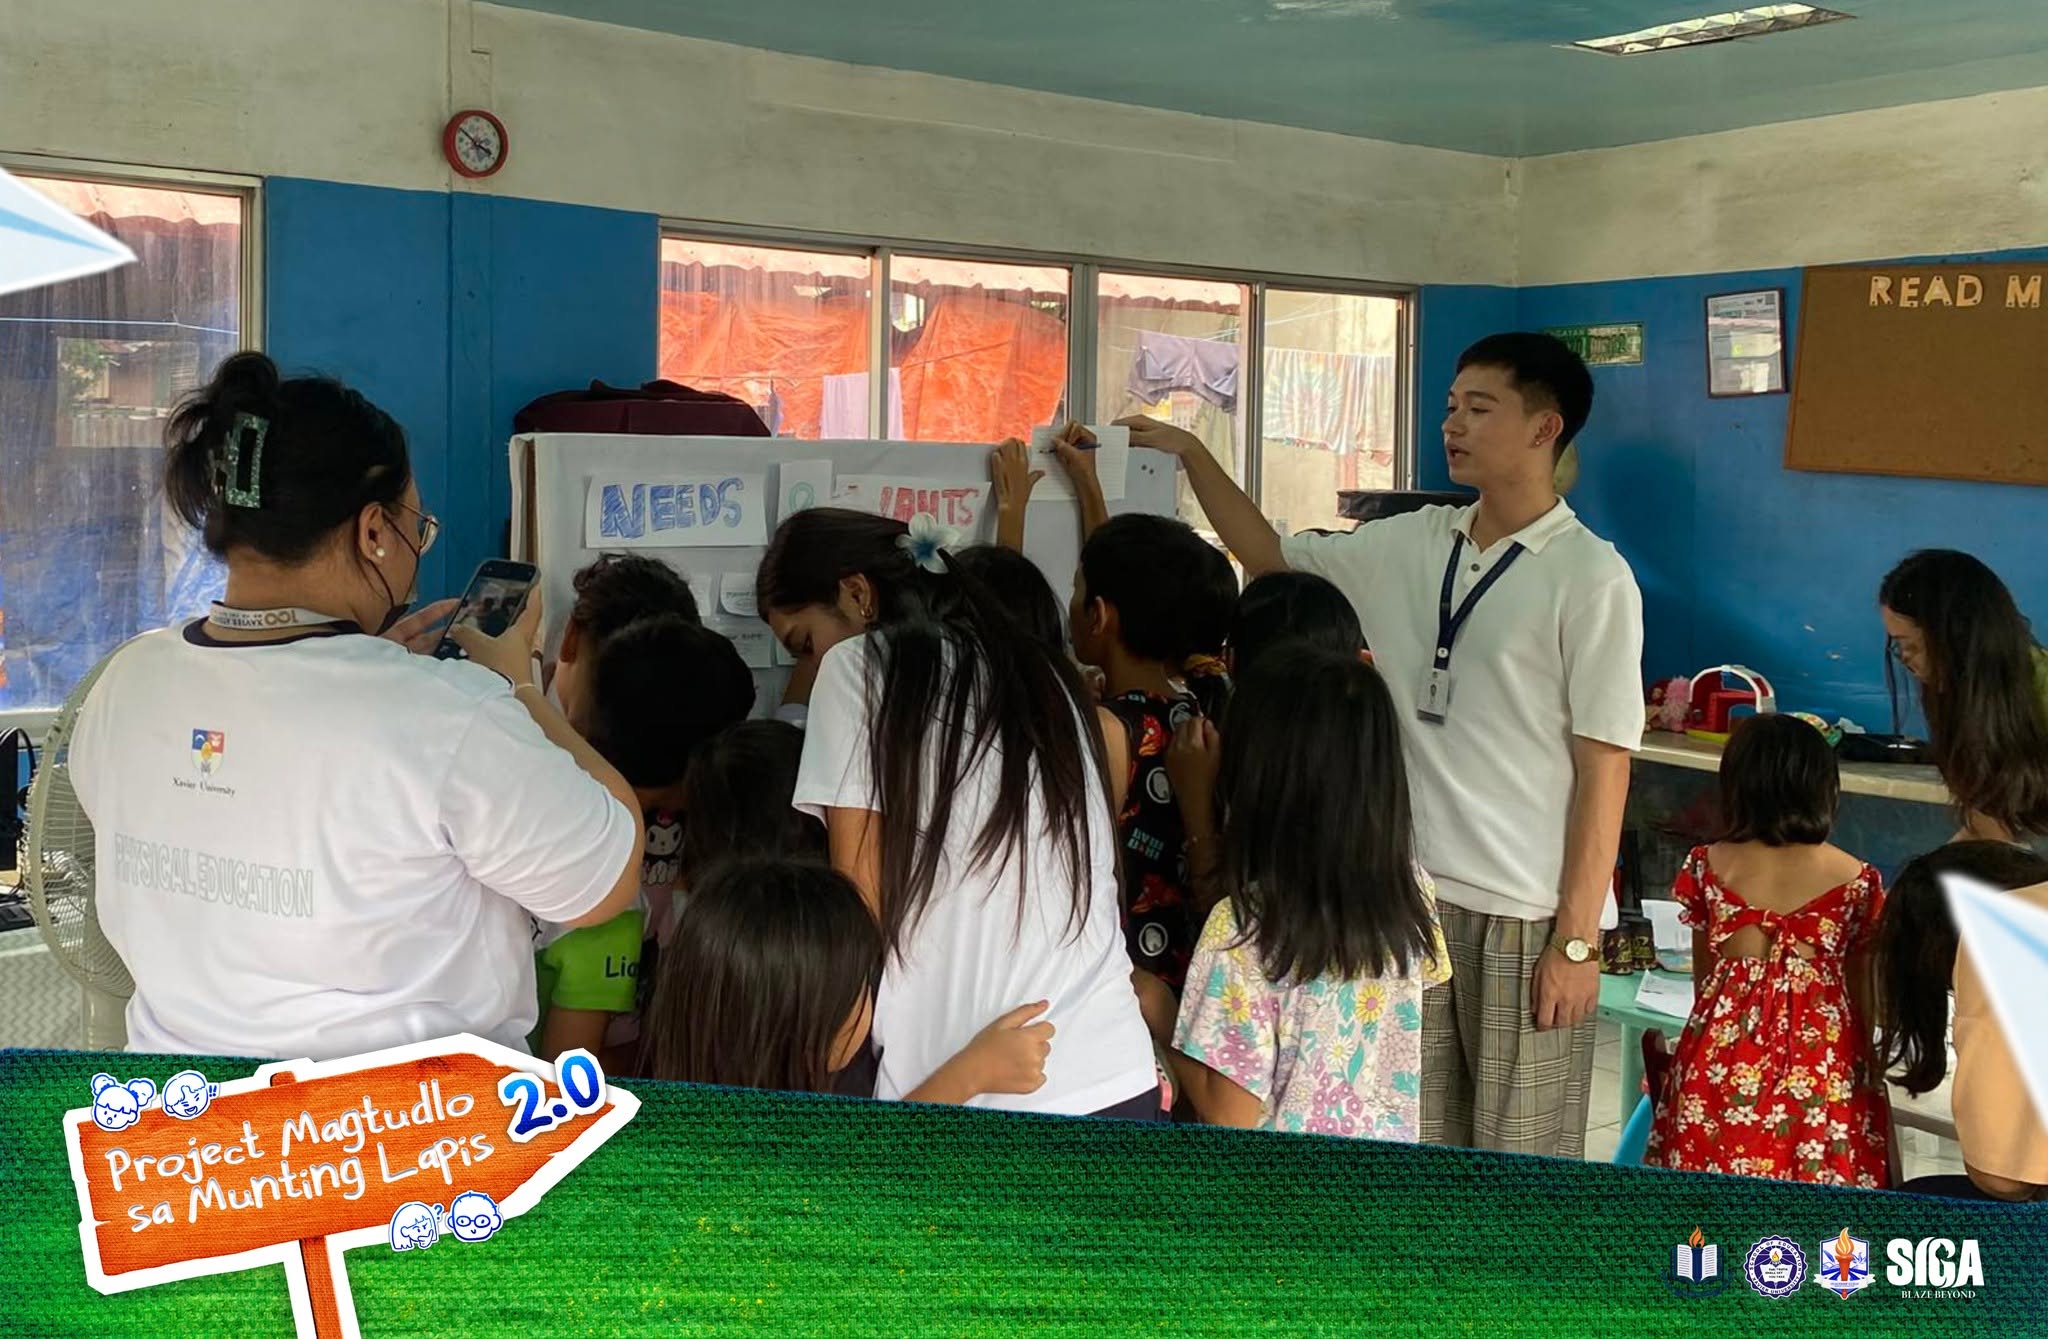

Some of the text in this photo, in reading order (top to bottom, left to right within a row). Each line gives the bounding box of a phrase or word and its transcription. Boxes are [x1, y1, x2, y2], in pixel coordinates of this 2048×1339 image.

[1869, 274, 1984, 308] READ
[600, 477, 744, 539] NEEDS
[173, 777, 235, 797] Xavier University
[114, 832, 313, 918] PHYSICAL EDUCATION
